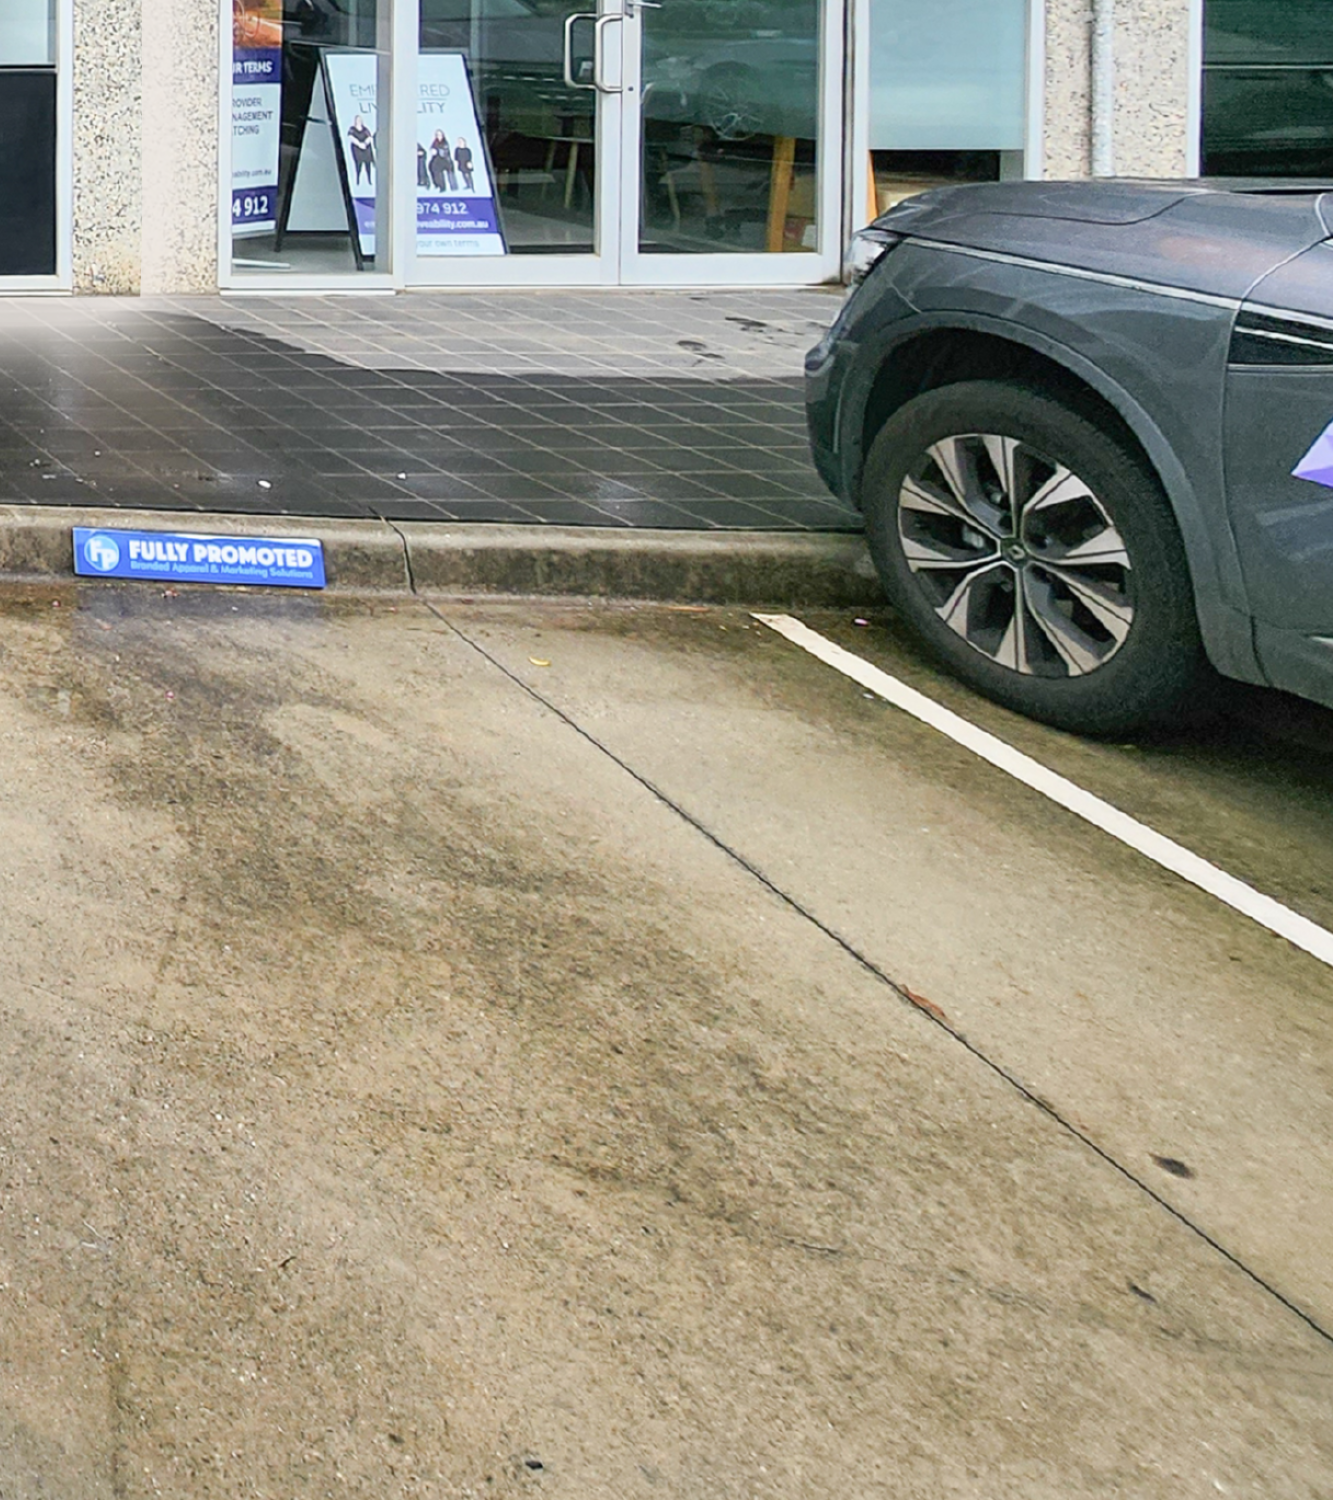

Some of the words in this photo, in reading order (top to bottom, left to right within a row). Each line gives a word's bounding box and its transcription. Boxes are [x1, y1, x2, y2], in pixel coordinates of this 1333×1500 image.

[244, 61, 273, 73] TERMS
[244, 196, 268, 216] 912
[442, 203, 468, 214] 912
[129, 540, 188, 562] FULLY
[193, 543, 313, 567] PROMOTED
[131, 560, 170, 571] Branded
[172, 562, 209, 574] Apparel
[221, 563, 268, 578] Marketing
[270, 567, 313, 579] Solutions
